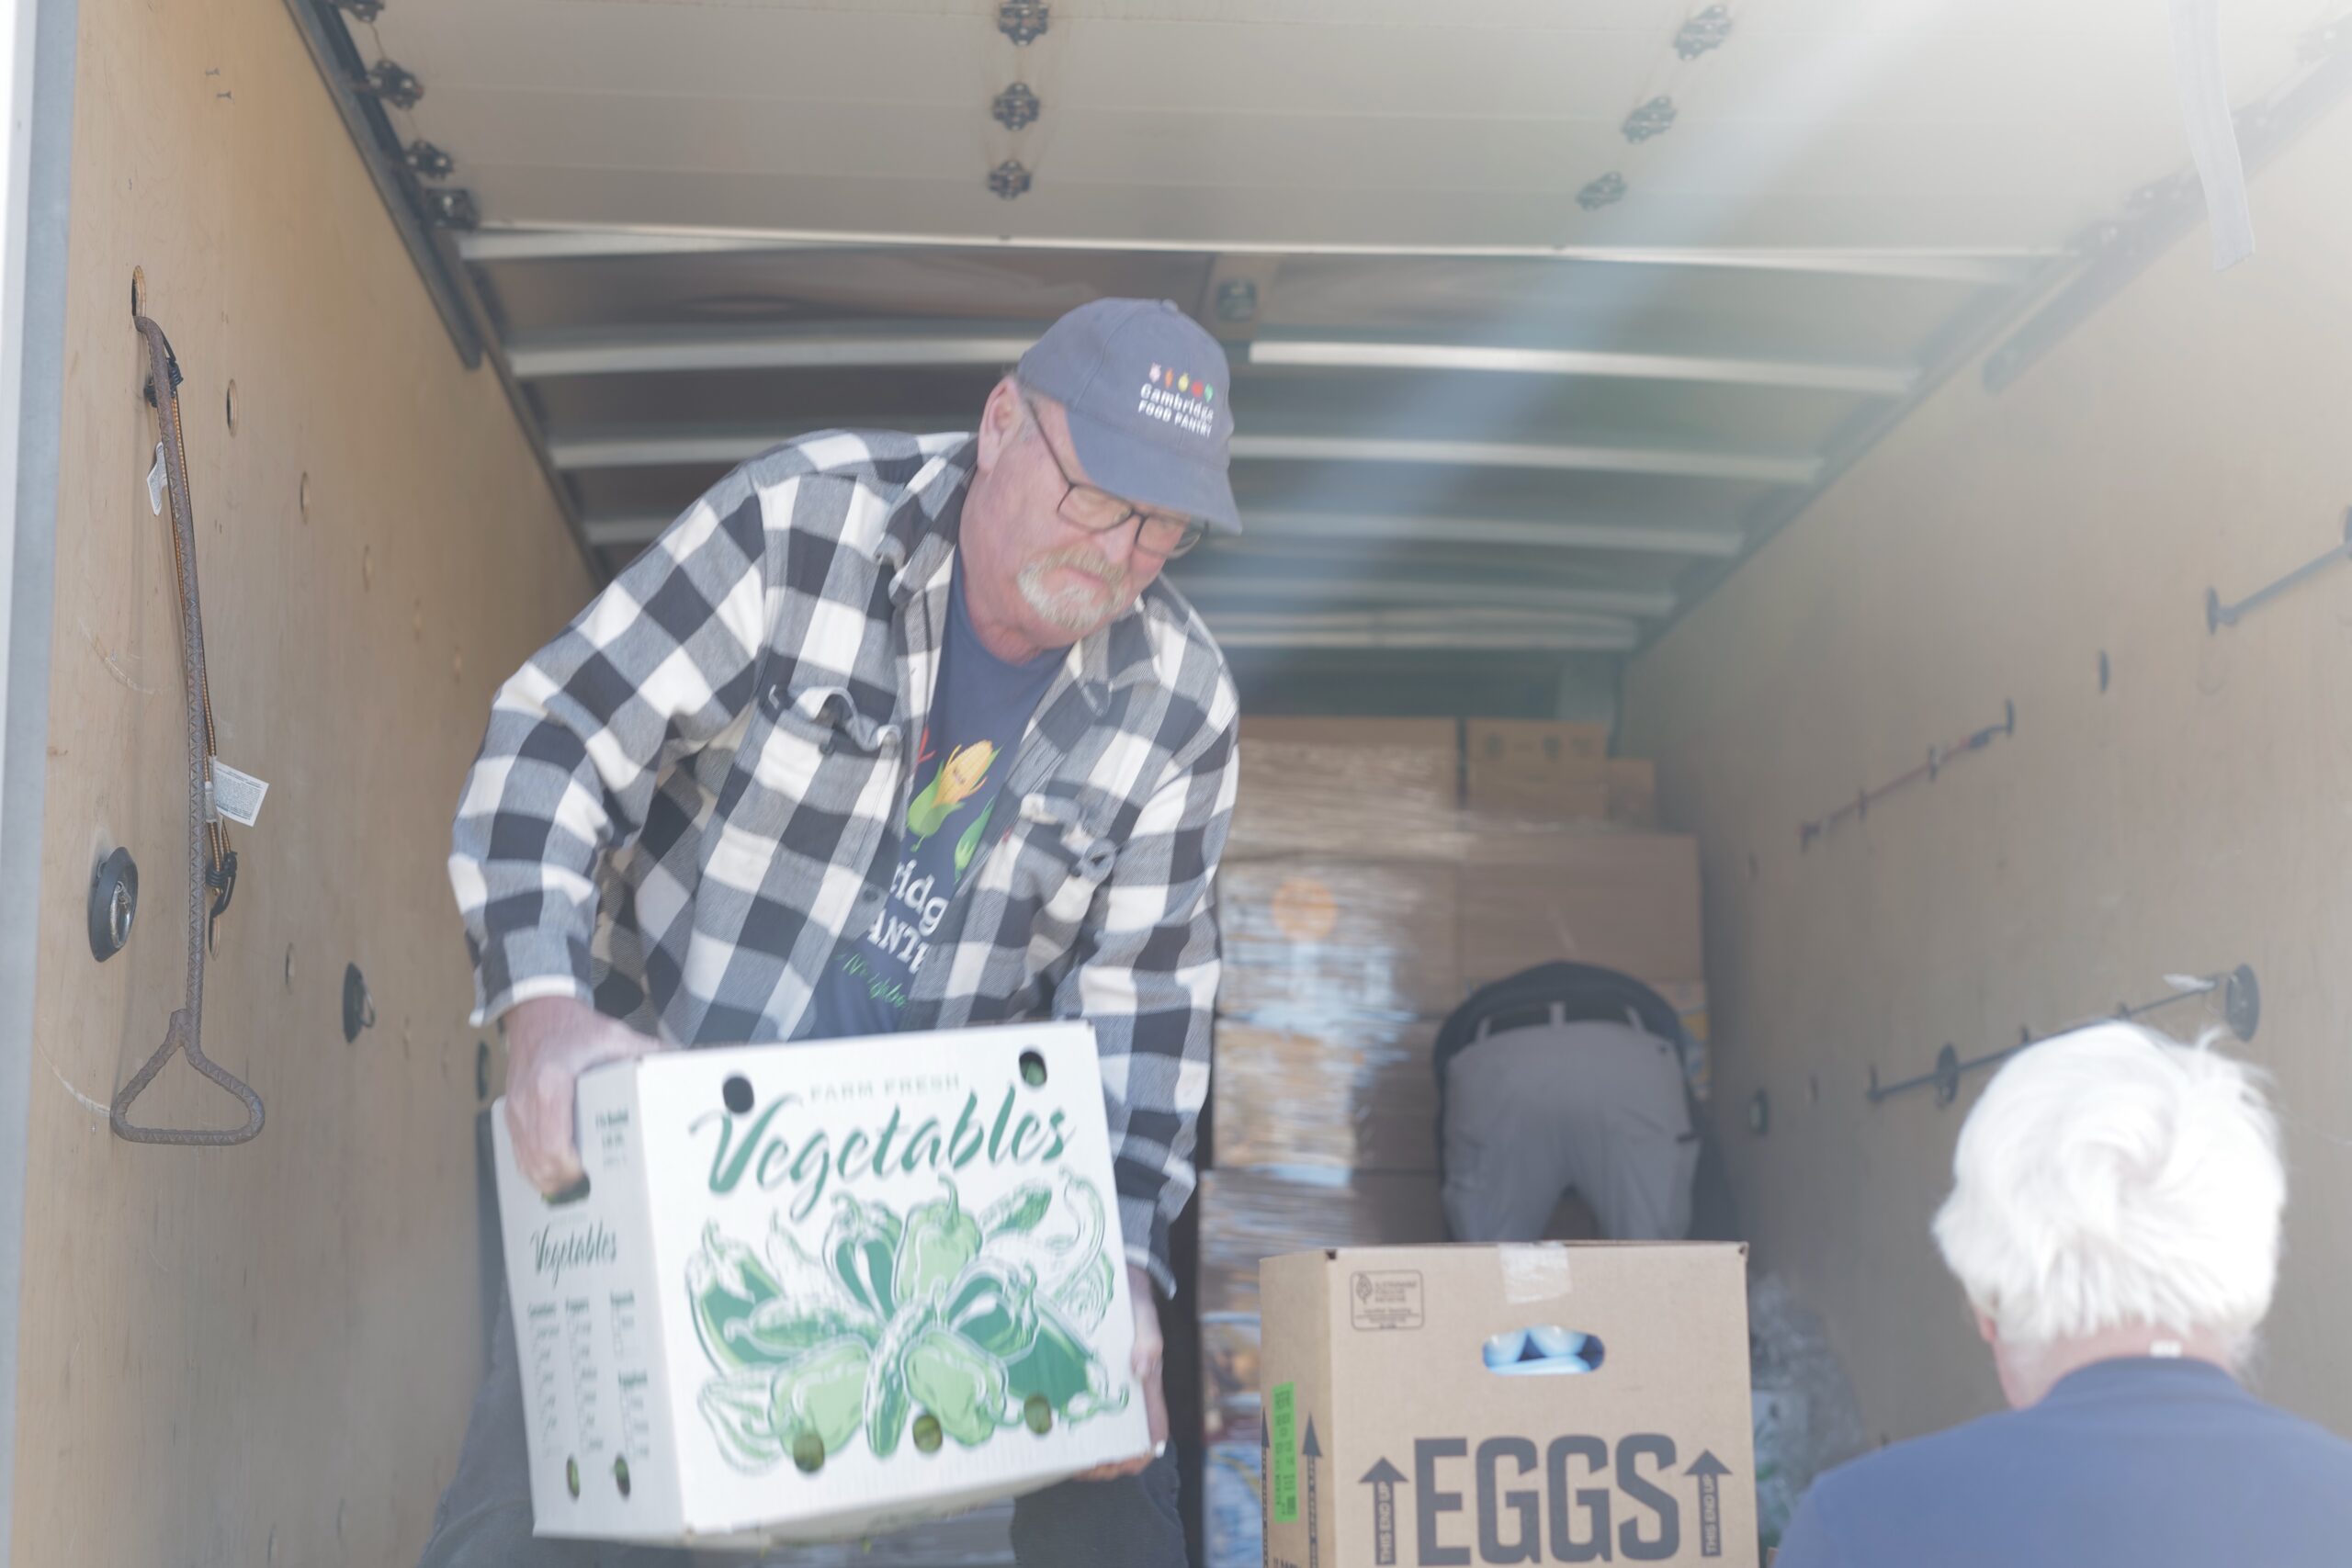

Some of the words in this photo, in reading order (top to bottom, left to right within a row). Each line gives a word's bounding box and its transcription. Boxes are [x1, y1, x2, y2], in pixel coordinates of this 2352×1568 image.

[1137, 399, 1172, 423] FOOD
[1173, 412, 1213, 439] PANTRY
[810, 1081, 874, 1101] FARM
[884, 1072, 960, 1097] FRESH
[689, 1084, 1076, 1223] Vegetables
[529, 1216, 618, 1291] Vegetables
[1378, 1481, 1391, 1501] UP
[1702, 1472, 1714, 1494] UP
[1414, 1432, 1681, 1567] EGGS
[1703, 1494, 1716, 1523] END
[1379, 1502, 1392, 1531] END
[1380, 1532, 1394, 1562] THIS
[1705, 1524, 1718, 1555] THIS
